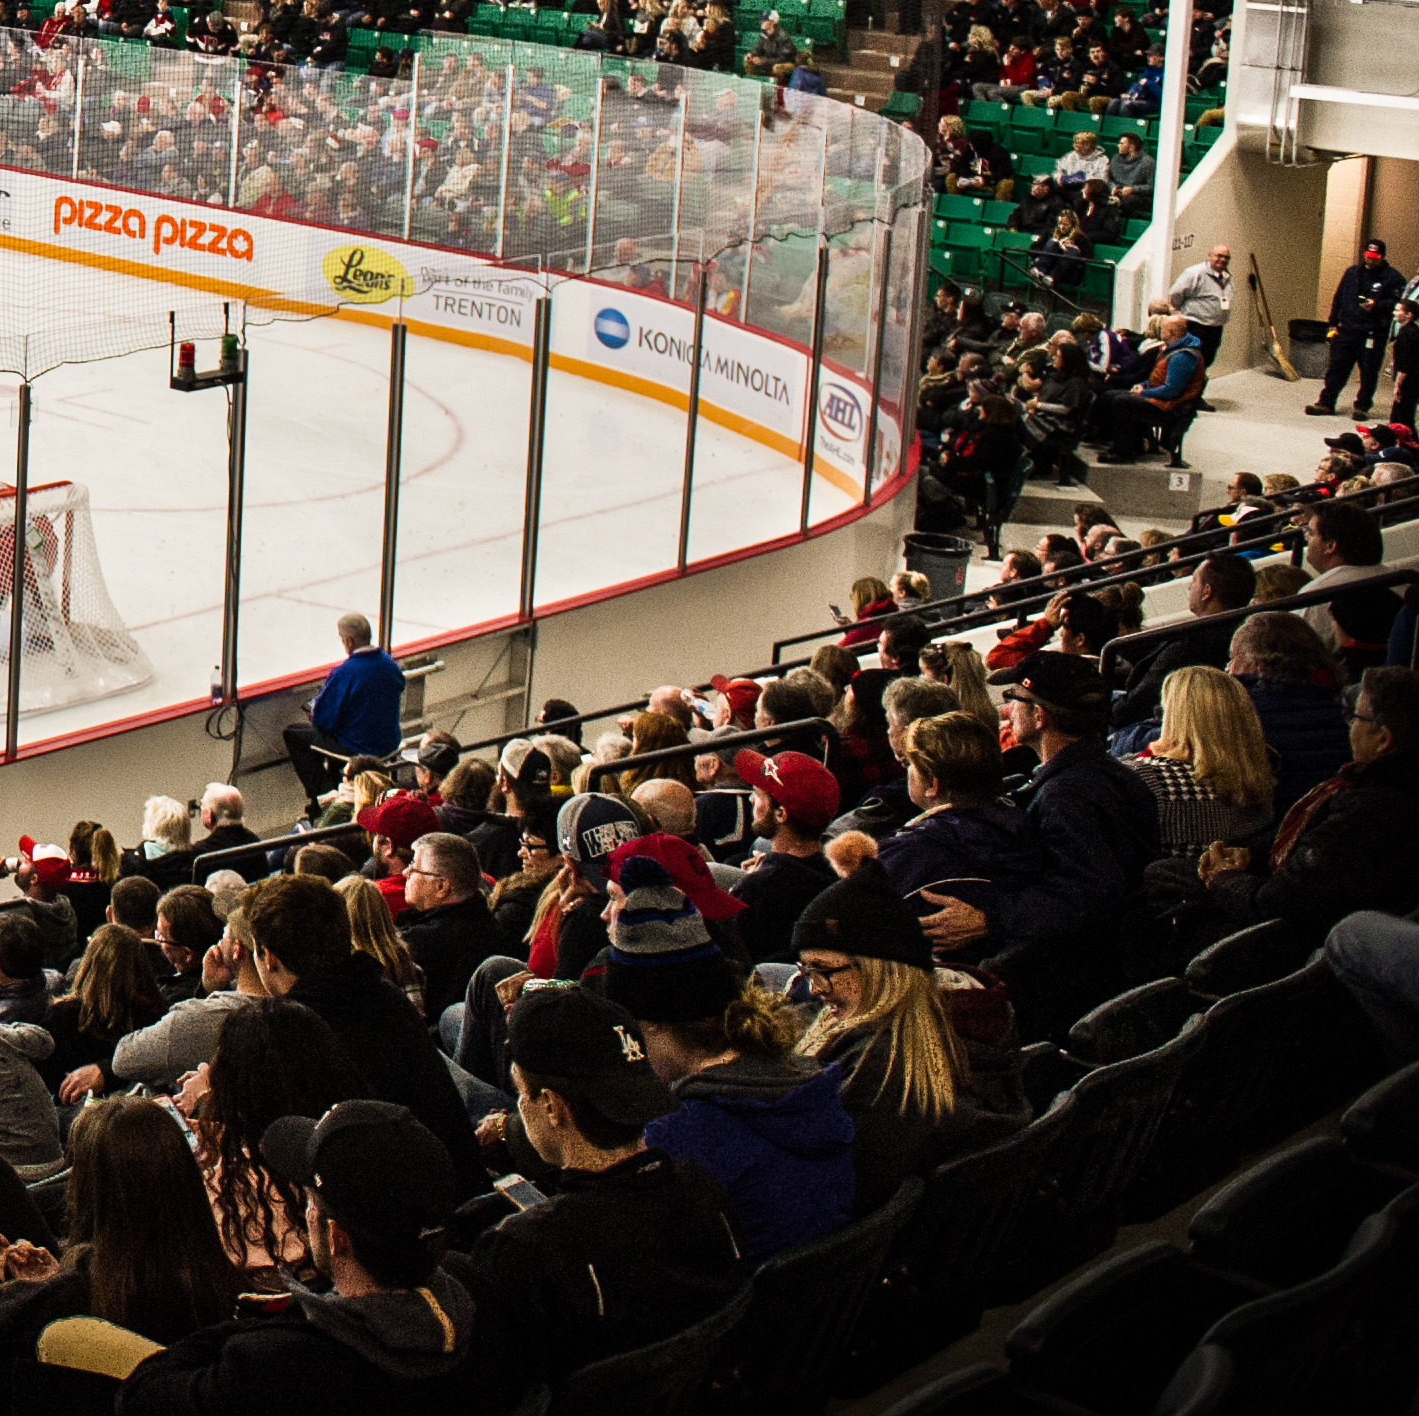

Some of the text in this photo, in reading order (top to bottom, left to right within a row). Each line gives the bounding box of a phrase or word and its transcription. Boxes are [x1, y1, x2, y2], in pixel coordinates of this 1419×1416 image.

[53, 195, 254, 263] pizza pizza
[333, 248, 397, 295] Leon's
[454, 276, 469, 288] of
[472, 277, 492, 292] the
[433, 294, 523, 328] TRENTON
[714, 354, 791, 406] MINOLTA
[823, 391, 857, 432] AHL
[612, 1025, 645, 1062] LA
